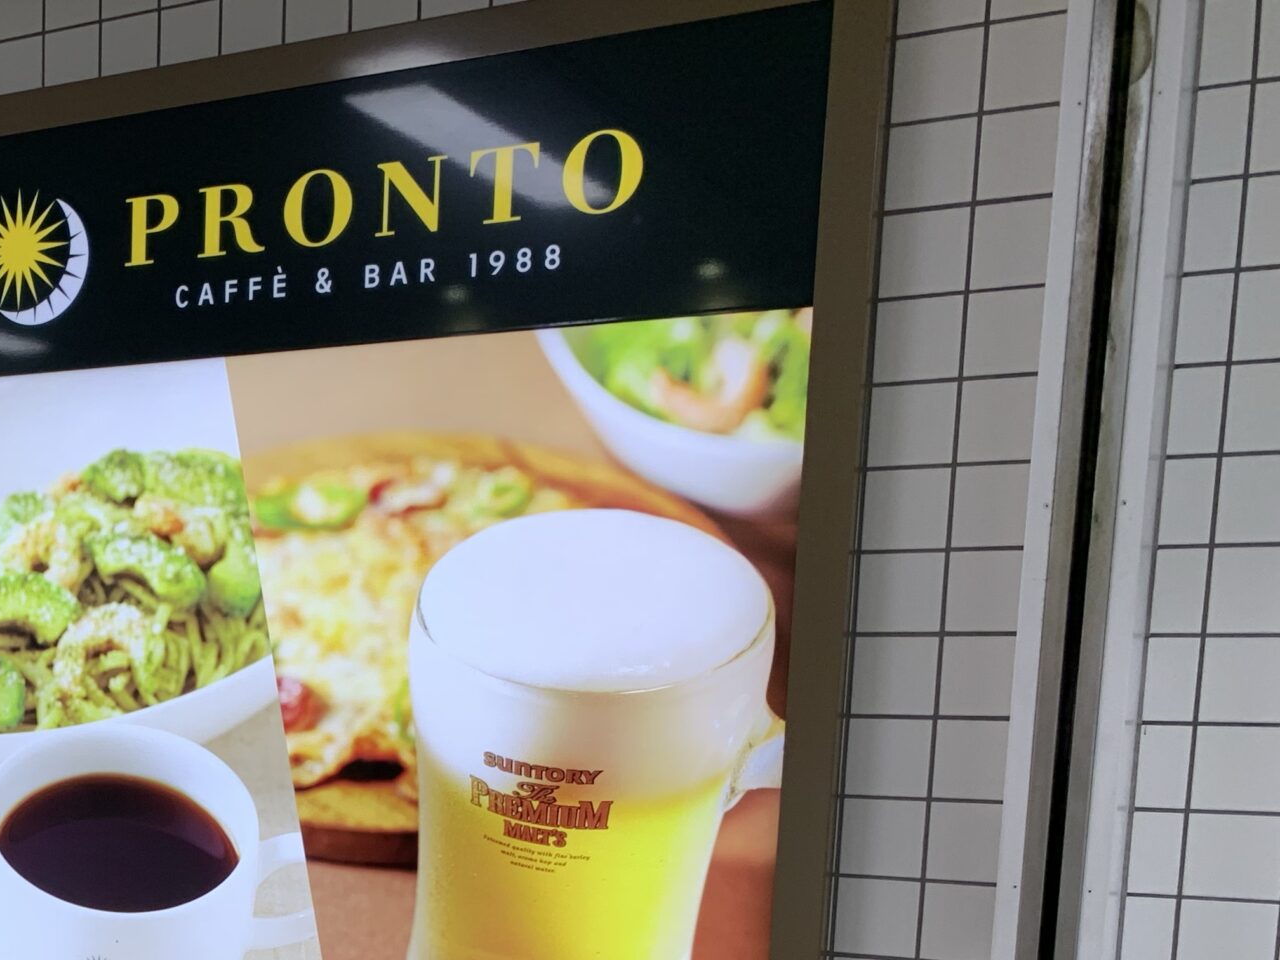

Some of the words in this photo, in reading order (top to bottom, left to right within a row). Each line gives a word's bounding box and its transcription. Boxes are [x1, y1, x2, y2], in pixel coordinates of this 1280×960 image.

[124, 128, 644, 268] PRONTO
[175, 266, 287, 308] CAFFÈ
[315, 267, 333, 294] &
[364, 257, 436, 289] BAR
[468, 243, 562, 279] 1988
[483, 751, 604, 785] SUNTORY
[469, 774, 613, 830] PREMIUM
